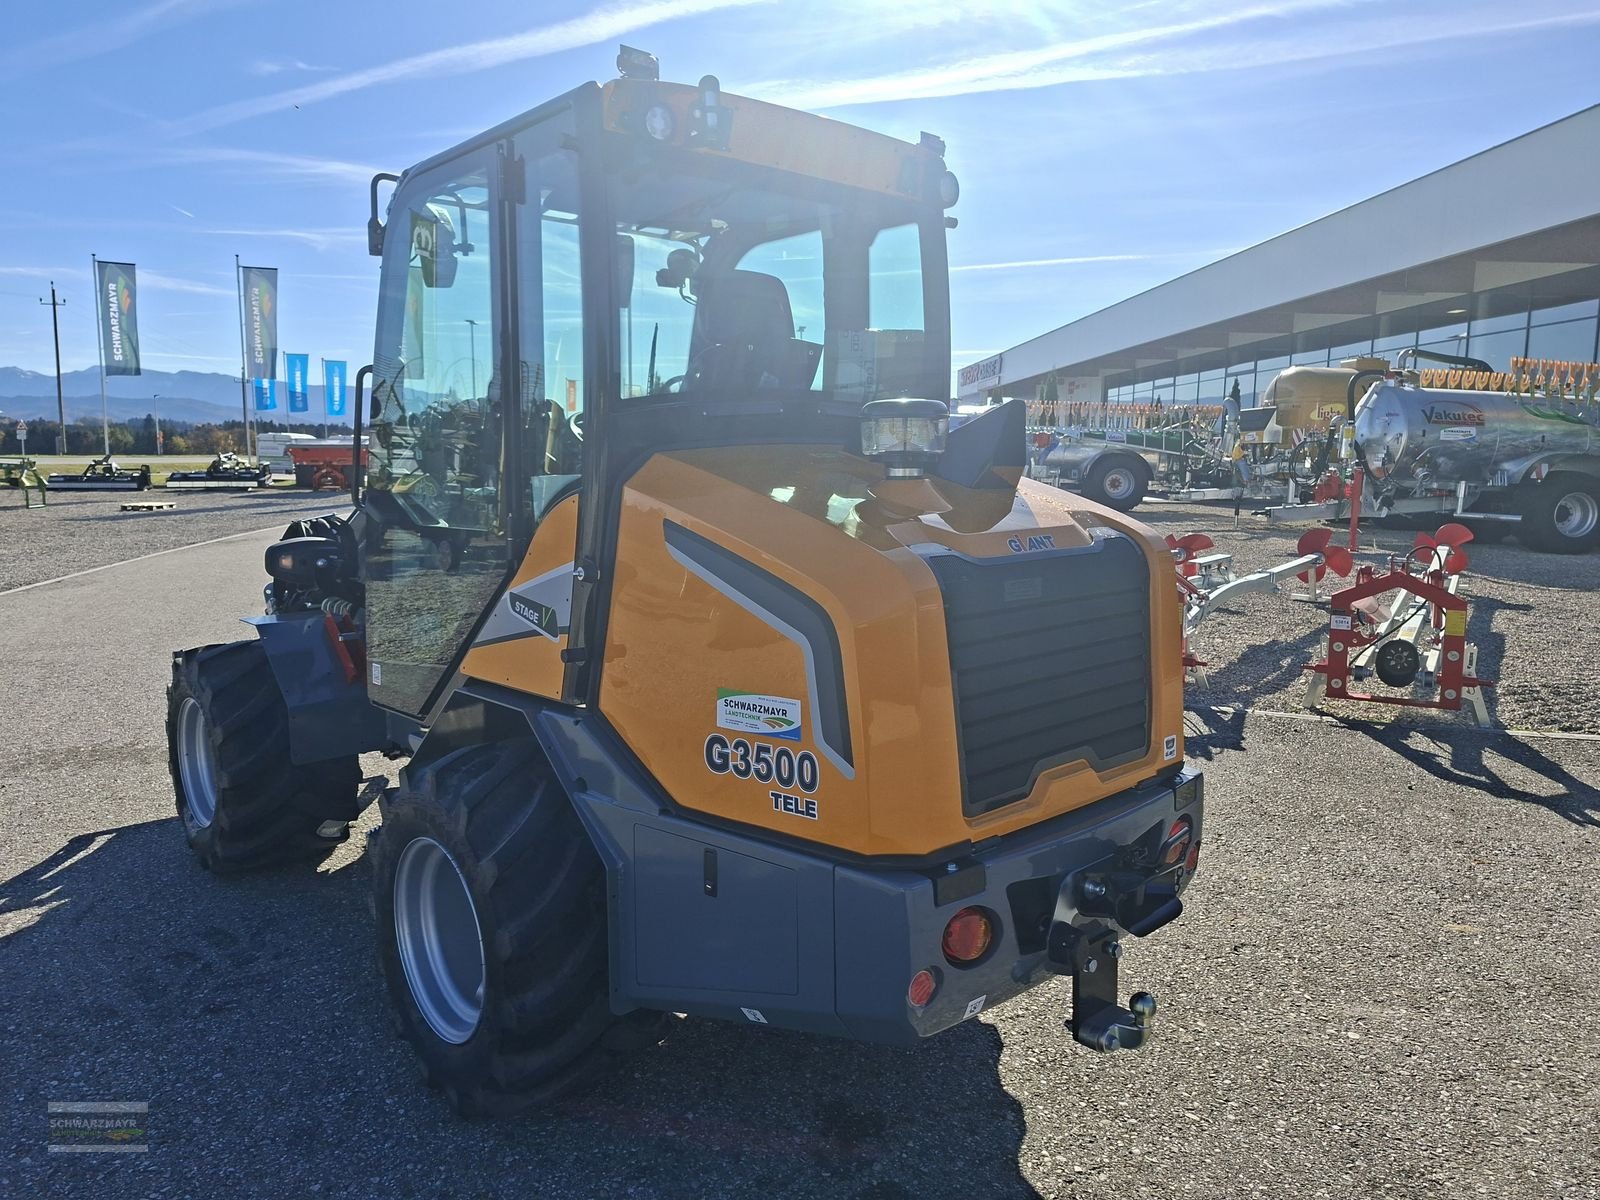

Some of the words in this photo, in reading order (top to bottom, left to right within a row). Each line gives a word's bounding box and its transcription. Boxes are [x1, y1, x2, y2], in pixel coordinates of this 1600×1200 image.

[108, 282, 123, 361] SCHWARZMAYR
[250, 287, 264, 364] SCHWARZMAYR
[1421, 406, 1485, 424] Vakutec
[514, 601, 539, 623] STAGE
[542, 607, 553, 628] V
[724, 698, 788, 717] SCHWARZMAYR
[725, 709, 760, 721] LANDTECHNIK
[704, 733, 819, 793] G3500
[770, 791, 817, 820] TELE
